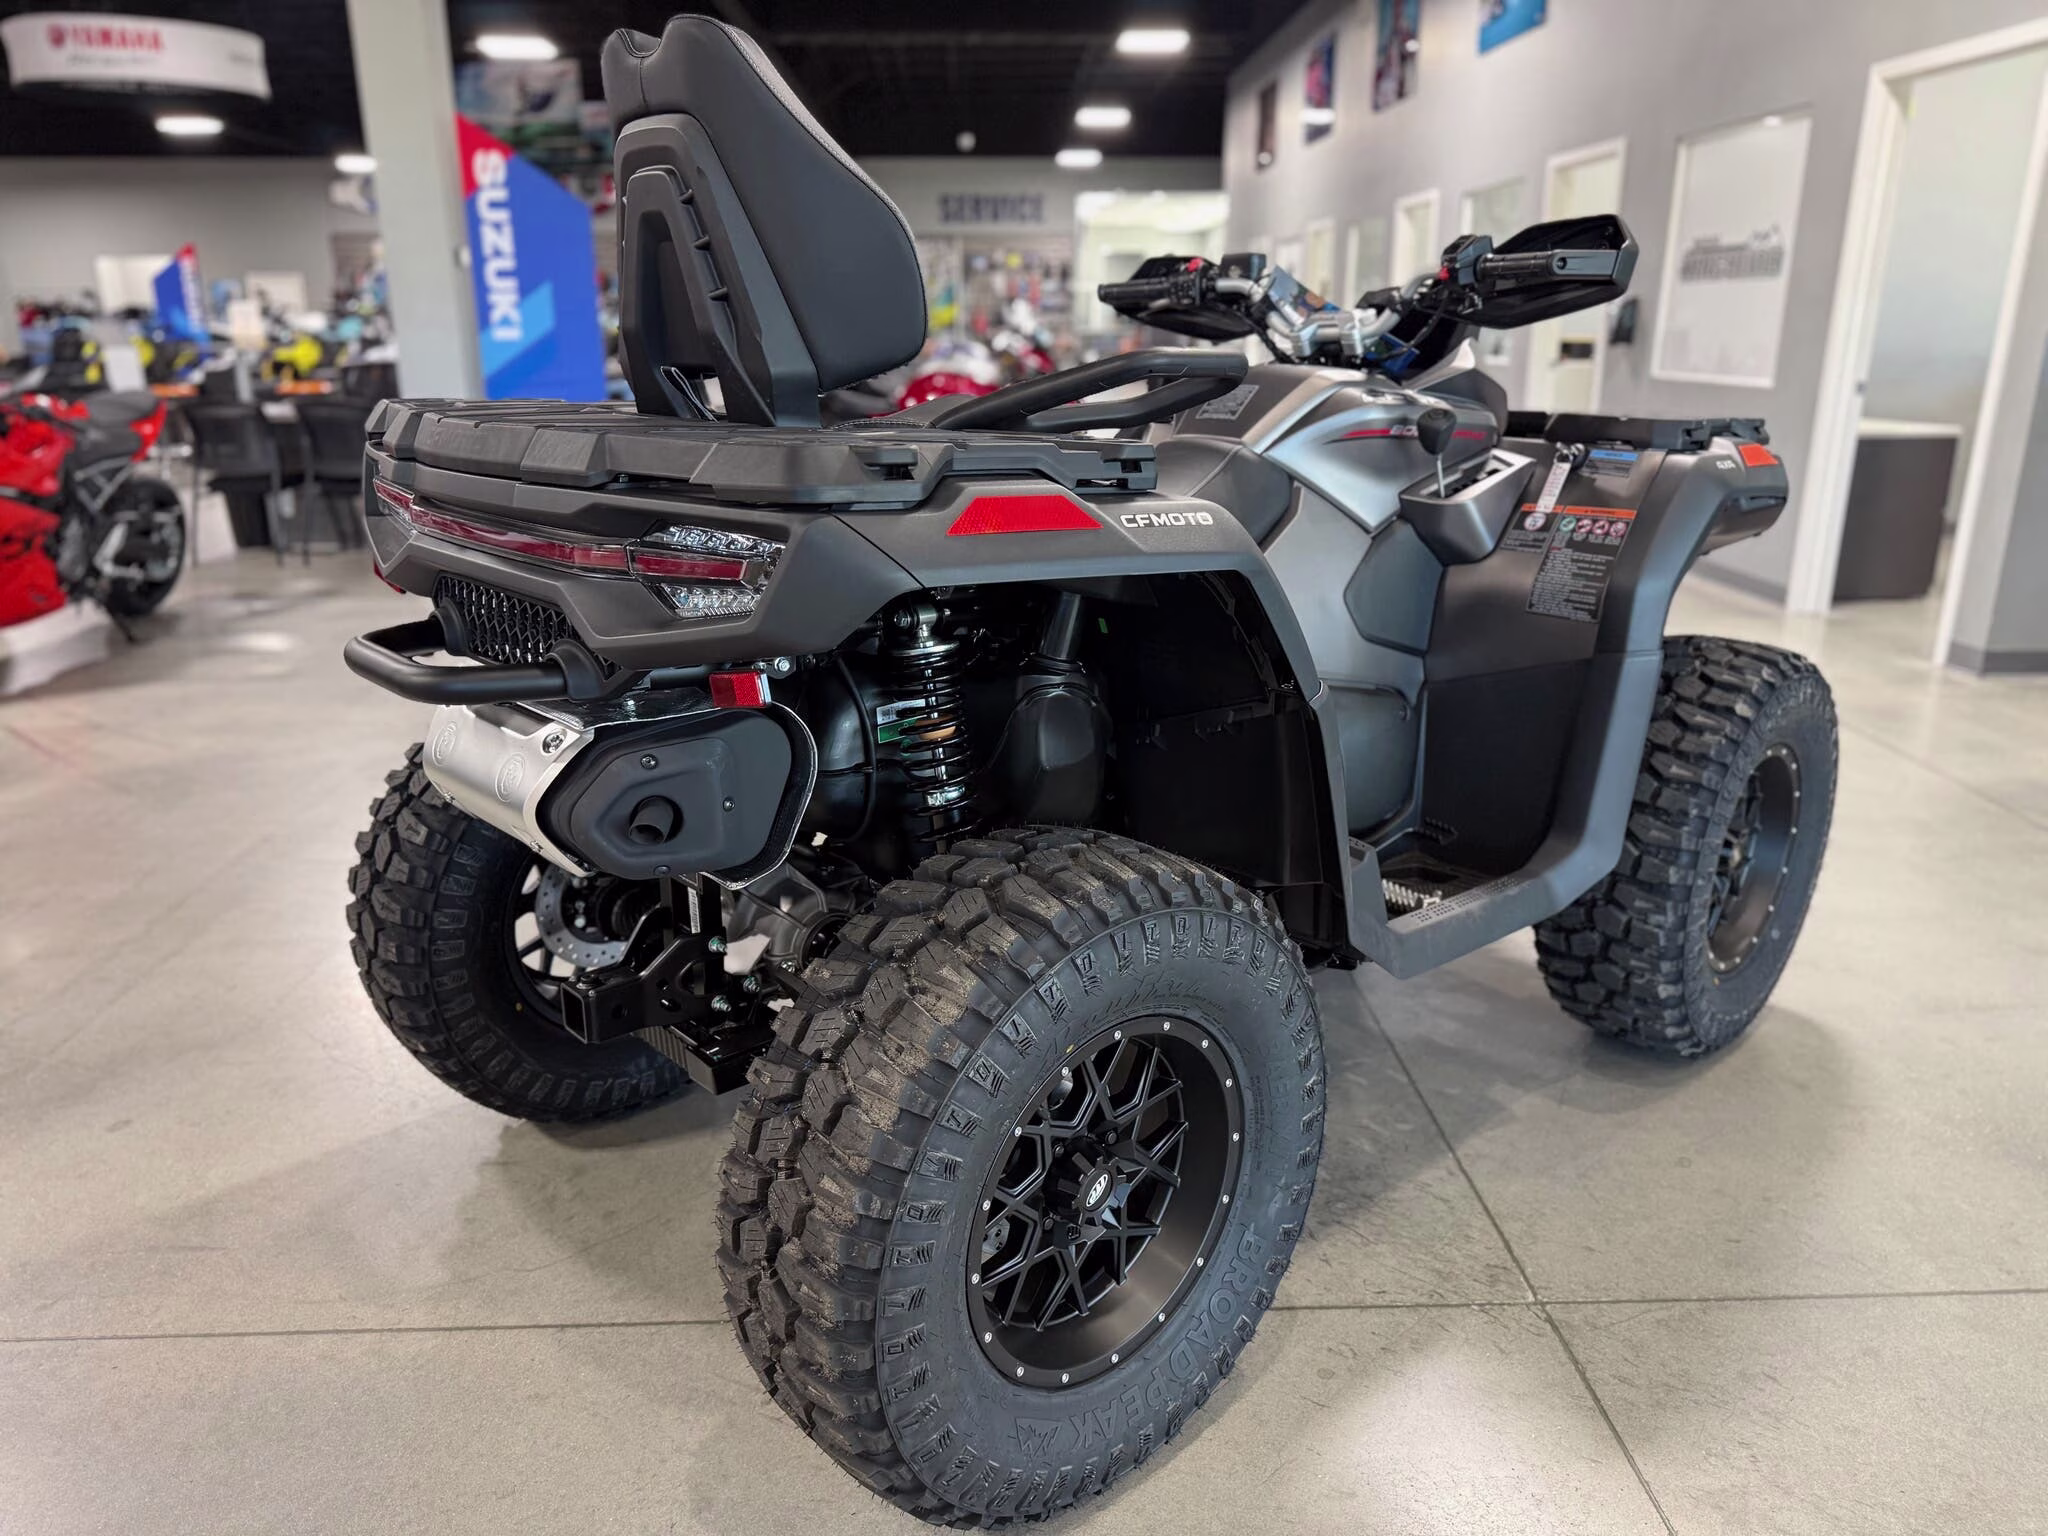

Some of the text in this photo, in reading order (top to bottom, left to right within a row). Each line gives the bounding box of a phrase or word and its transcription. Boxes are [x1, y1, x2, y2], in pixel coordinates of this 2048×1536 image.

[938, 194, 1044, 222] SERVICE
[471, 148, 524, 342] SUZUKI
[1120, 511, 1214, 528] CFMOTO
